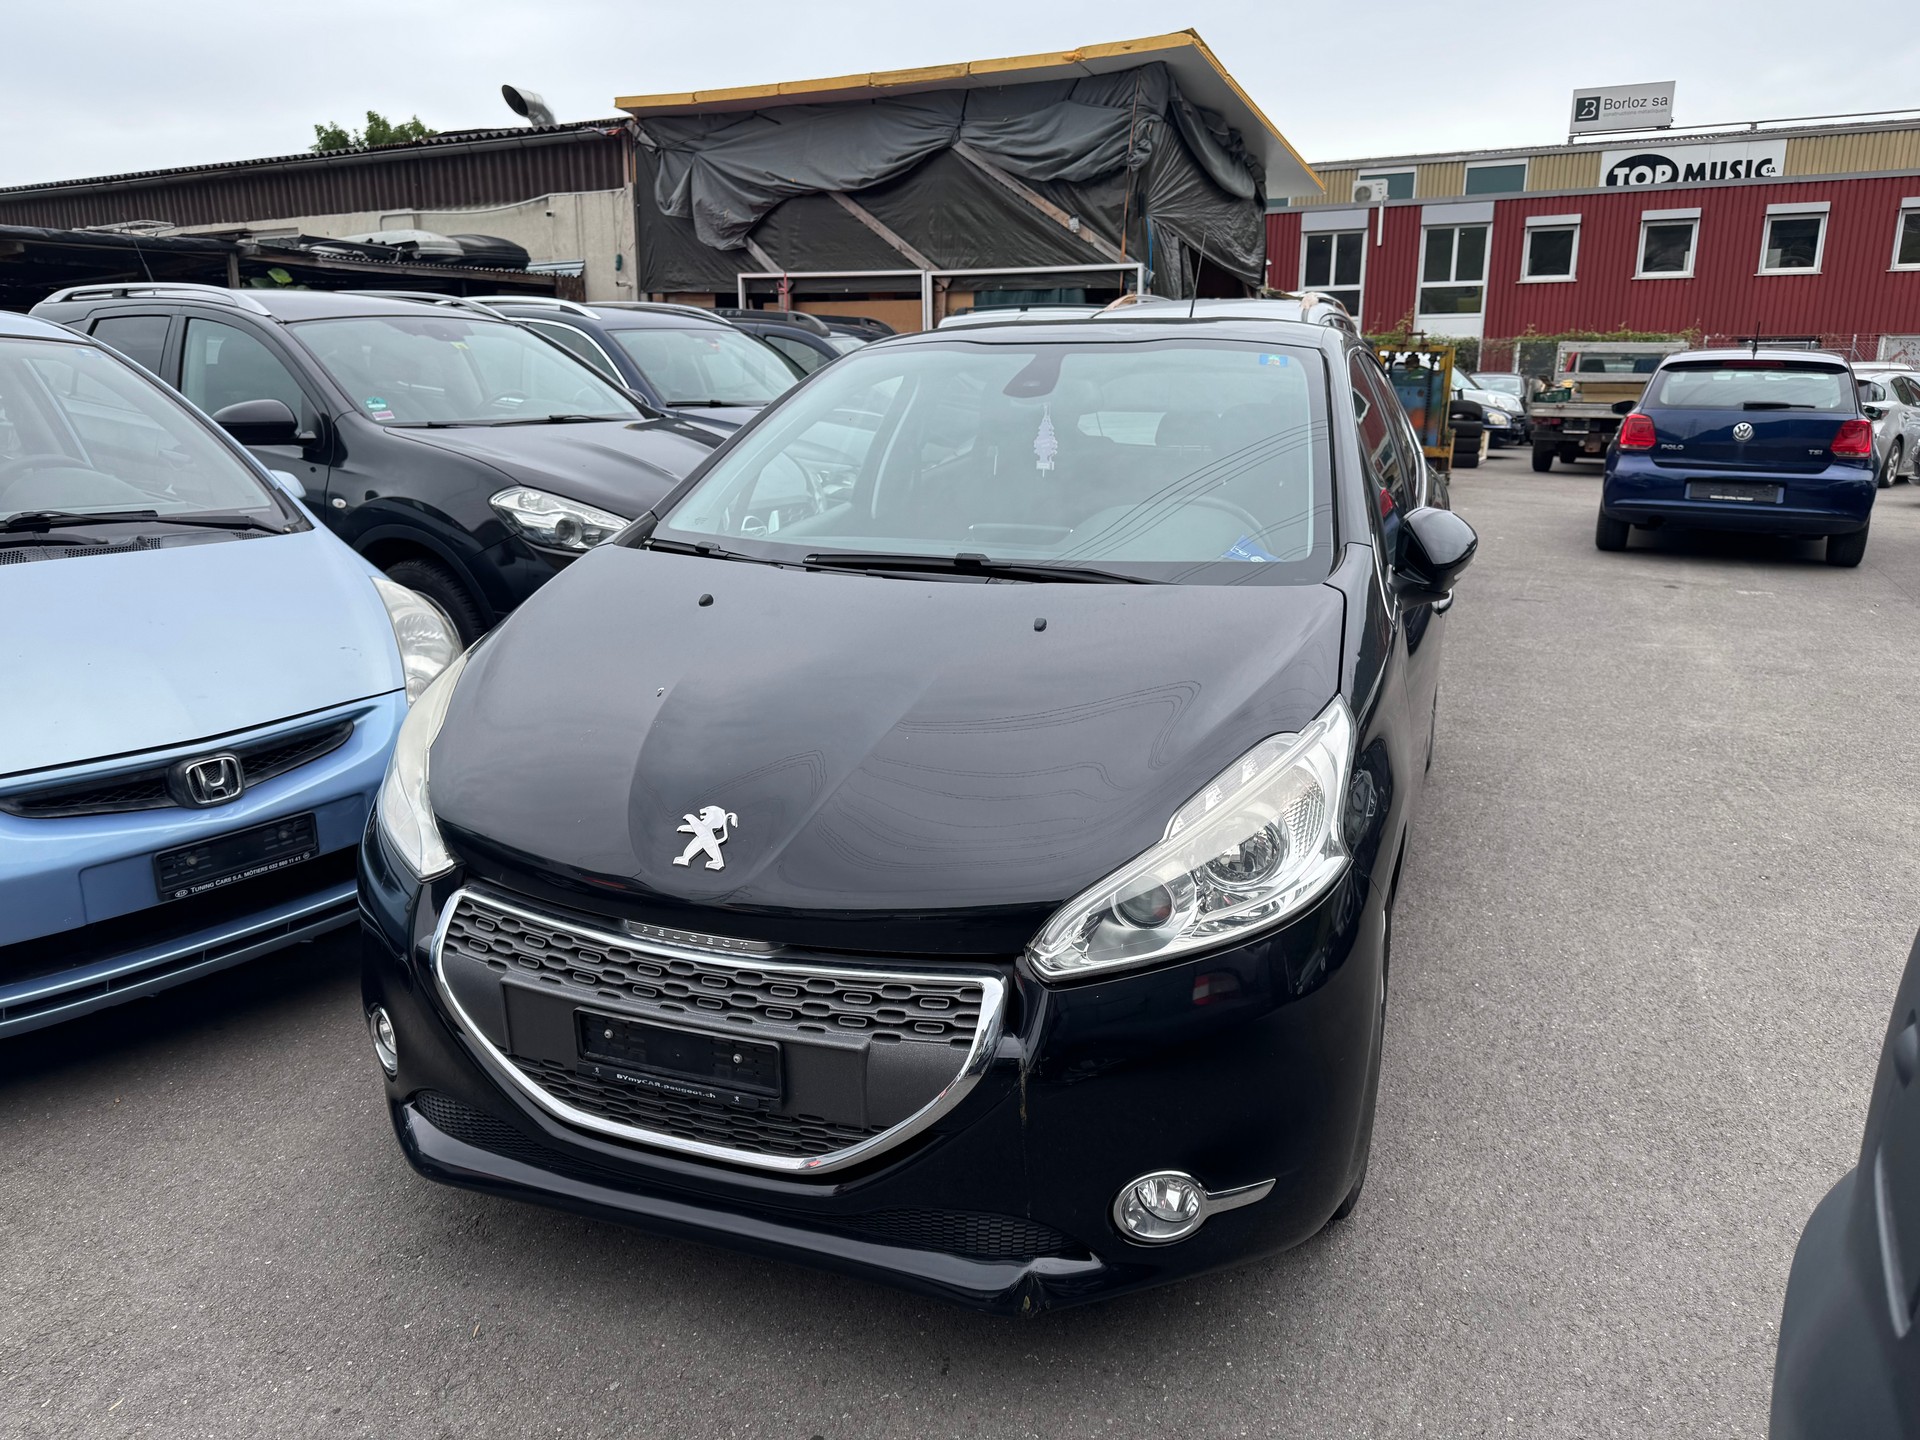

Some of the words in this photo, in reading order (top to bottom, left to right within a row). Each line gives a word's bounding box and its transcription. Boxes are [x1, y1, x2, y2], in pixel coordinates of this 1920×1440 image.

[1603, 96, 1647, 110] Borloz
[1652, 96, 1669, 107] sa
[1613, 164, 1673, 186] TOP
[1682, 158, 1773, 182] MUSIC
[1765, 166, 1777, 174] SA
[190, 882, 214, 893] TUNING
[215, 877, 232, 886] CARS
